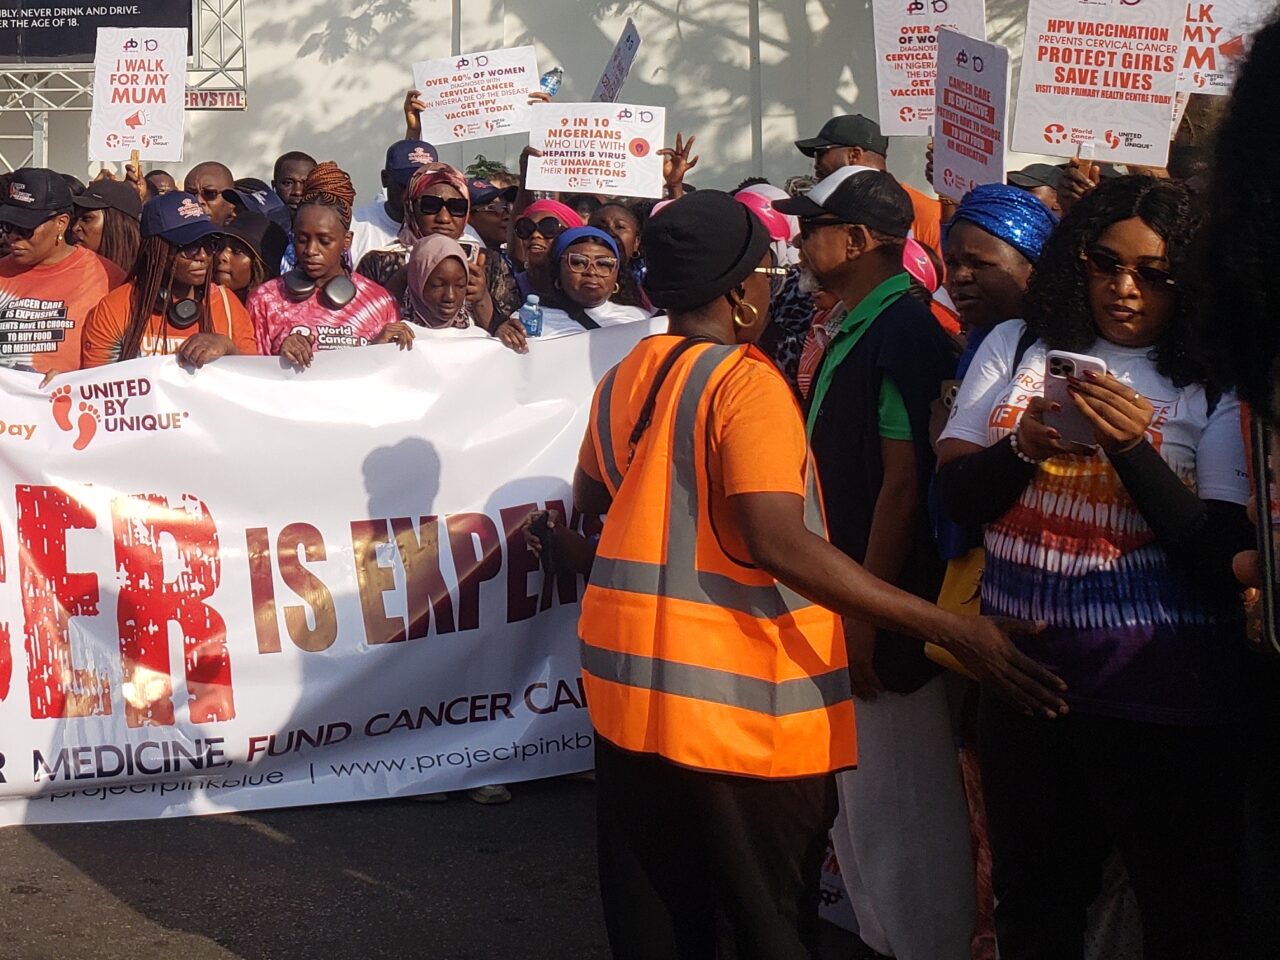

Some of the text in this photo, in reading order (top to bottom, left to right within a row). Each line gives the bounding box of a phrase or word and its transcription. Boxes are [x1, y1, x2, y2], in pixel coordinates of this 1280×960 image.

[20, 8, 52, 17] NEVER
[54, 7, 84, 16] DRINK
[86, 6, 108, 16] AND
[109, 5, 141, 15] DRIVE.
[11, 19, 29, 28] THE
[31, 18, 50, 28] AGE
[52, 18, 65, 27] OF
[67, 17, 80, 27] 18.
[900, 26, 931, 35] OVER
[1047, 19, 1169, 42] HPV VACCINATION
[1183, 26, 1223, 43] MY
[898, 36, 913, 45] OF
[1038, 35, 1178, 54] PREVENTS CERVICAL CANCER
[885, 53, 934, 62] CERVICAL
[1037, 46, 1175, 73] PROTECT GIRLS
[116, 59, 164, 72] I WALK
[894, 62, 903, 71] IN
[110, 74, 170, 85] FOR MY
[425, 66, 525, 87] OVER 40% OF WOMEN
[906, 71, 921, 79] THE
[1054, 67, 1153, 91] SAVE LIVES
[450, 77, 501, 90] DIAGNOSED WITH
[111, 88, 167, 104] MUM
[439, 81, 514, 99] CERVICAL CANCER
[890, 88, 935, 97] VACCINE
[1035, 84, 1172, 105] VISIT YOUR PRIMARY HEALTH CENTRE TODAY
[435, 98, 462, 107] NIGERIA
[463, 96, 474, 104] DIE
[501, 87, 529, 97] DISEASE
[460, 98, 497, 111] GET HPV
[444, 104, 515, 120] VACCINE TODAY.
[560, 118, 610, 128] 9 IN 10
[547, 128, 622, 140] NIGERIANS
[1071, 127, 1093, 135] World
[544, 139, 626, 150] WHO LIVE WITH
[542, 150, 586, 158] HEPATITIS
[598, 152, 626, 160] VIRUS
[542, 158, 625, 169] ARE UNAWARE OF
[540, 166, 627, 178] THEIR INFECTIONS
[9, 299, 63, 310] CANCER CARE
[6, 310, 14, 318] IS
[37, 321, 46, 329] TO
[46, 320, 74, 328] CHOOSE
[317, 326, 352, 335] World
[7, 331, 52, 341] TO BUY FOOD
[318, 334, 357, 346] Cancer
[2, 342, 57, 353] OR MEDICATION
[80, 377, 151, 400] UNITED
[103, 400, 129, 417] BY
[104, 413, 181, 432] UNIQUE
[245, 522, 338, 654] IS
[33, 737, 233, 783] MEDICINE,
[247, 721, 352, 762] FUND
[364, 692, 514, 737] CANCER
